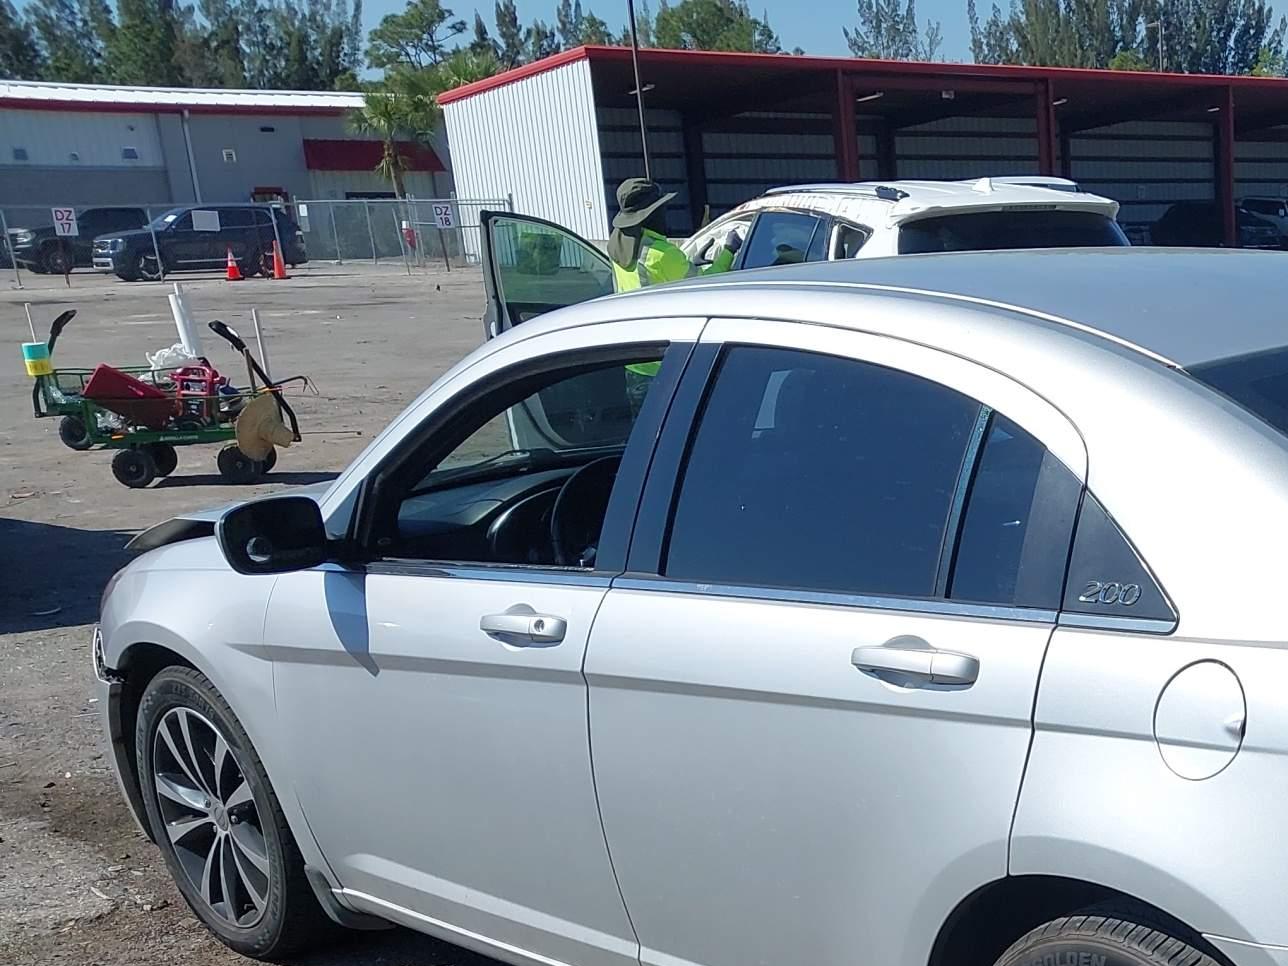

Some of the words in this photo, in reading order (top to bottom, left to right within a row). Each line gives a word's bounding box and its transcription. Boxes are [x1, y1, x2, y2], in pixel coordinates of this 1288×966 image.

[54, 209, 74, 221] DZ
[434, 206, 450, 216] DZ
[439, 217, 451, 226] 18
[60, 222, 72, 234] 17
[1078, 580, 1142, 606] 200
